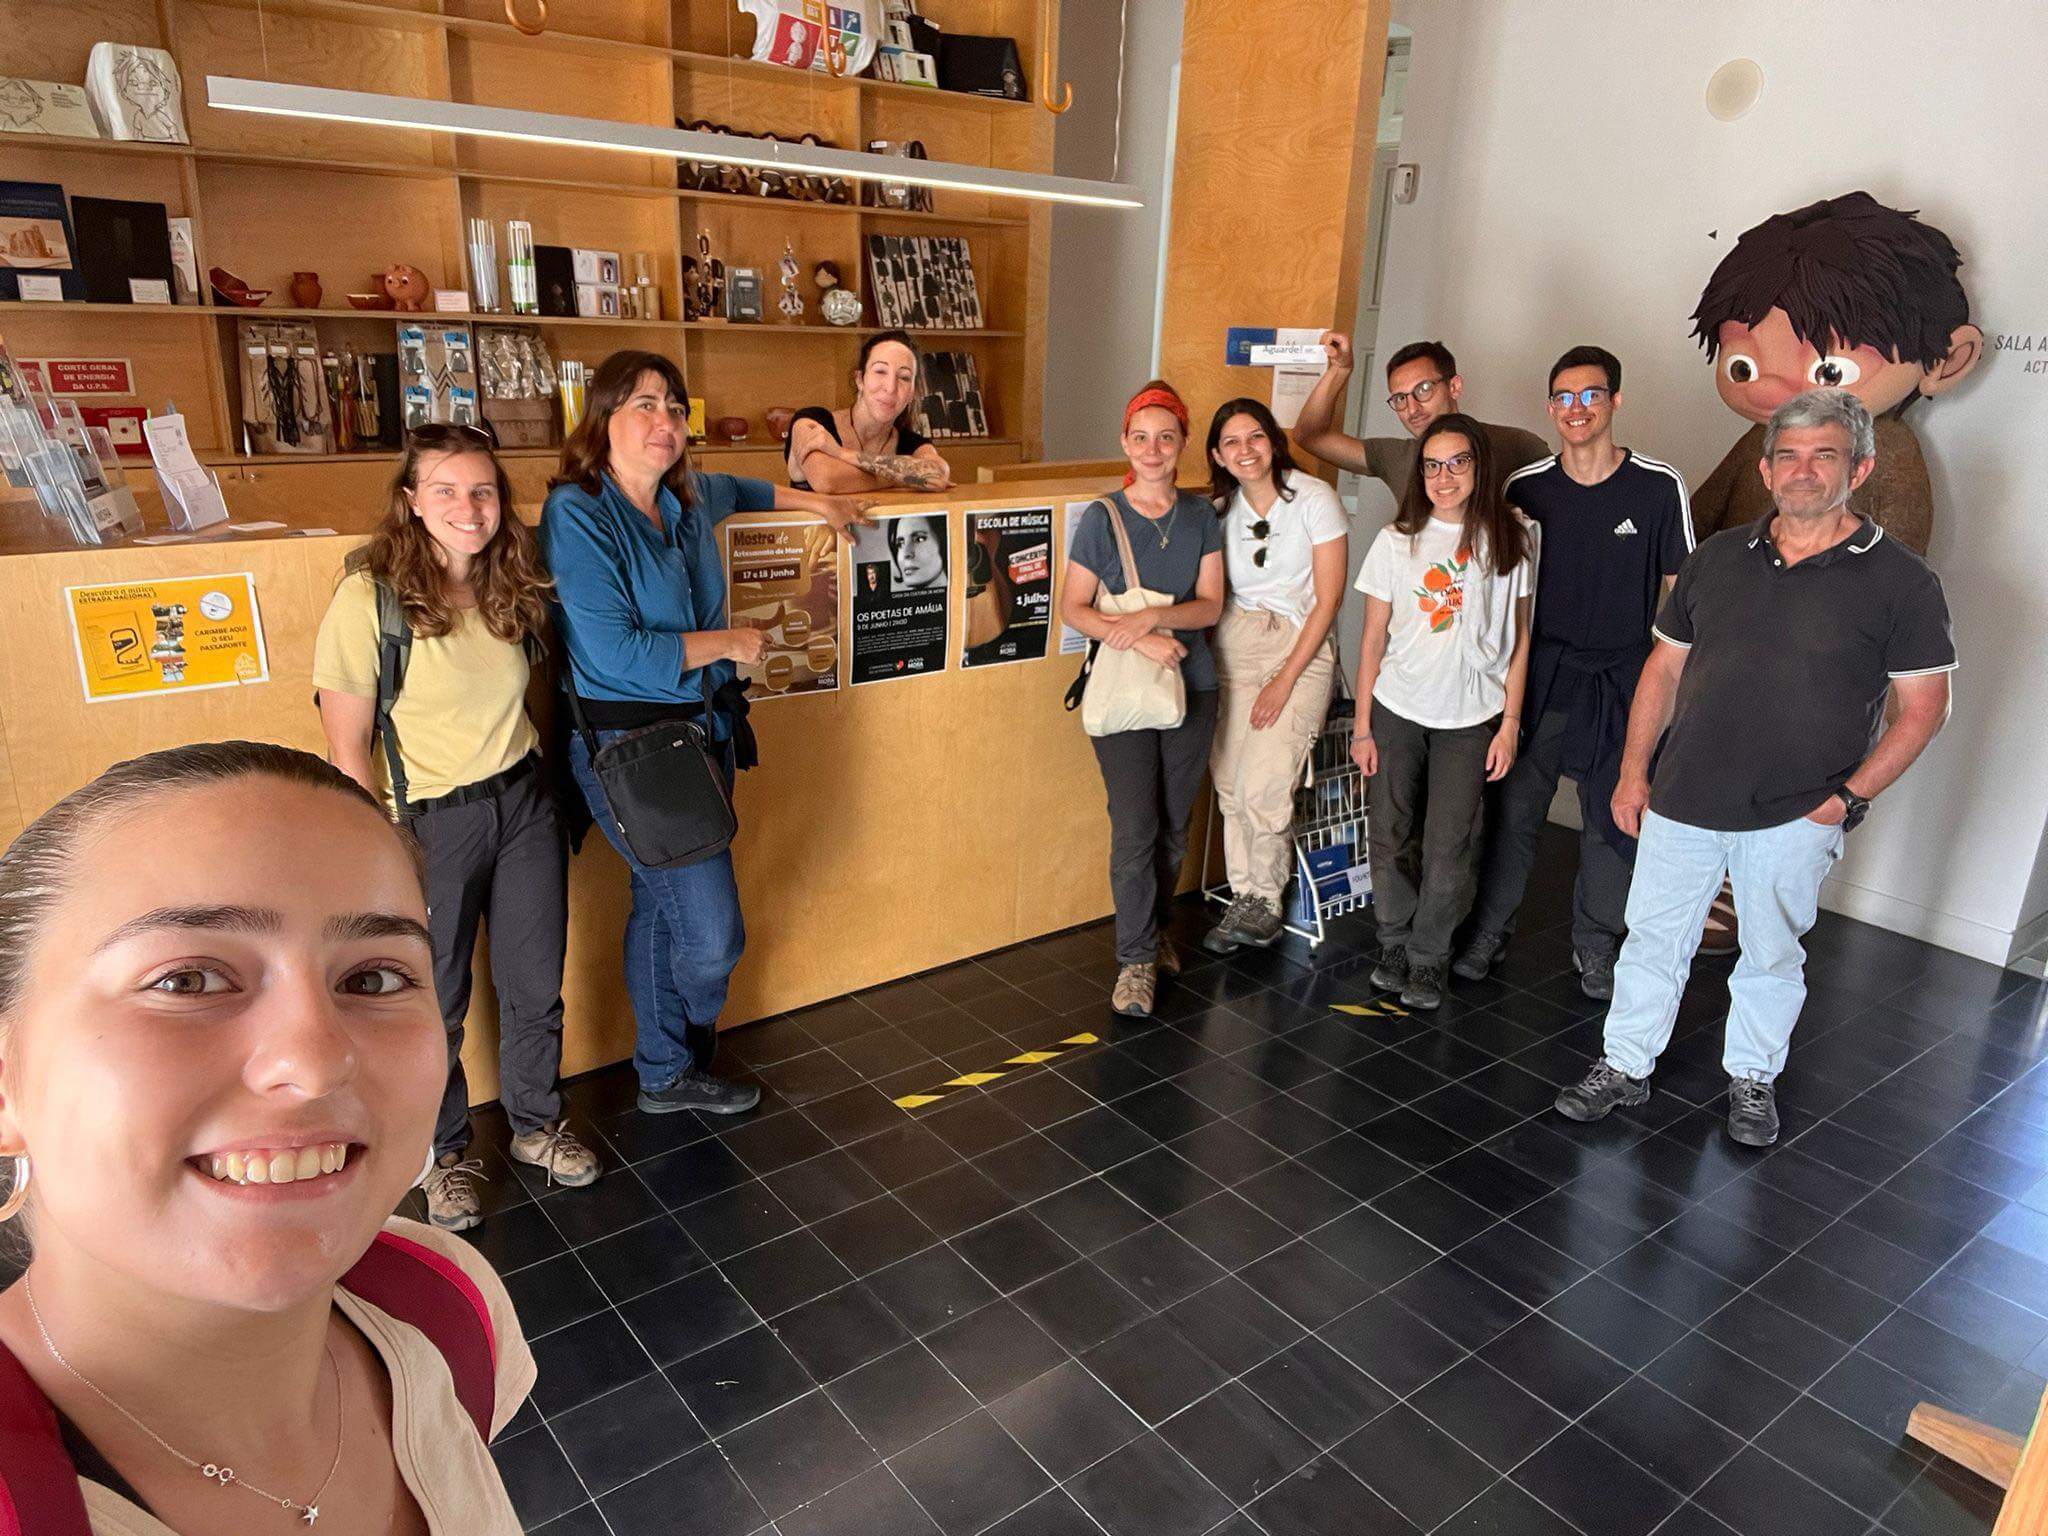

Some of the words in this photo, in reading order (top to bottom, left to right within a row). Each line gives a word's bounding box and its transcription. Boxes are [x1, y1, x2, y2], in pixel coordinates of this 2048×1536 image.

[1994, 334, 2032, 351] SALA
[57, 364, 88, 372] CORTE
[90, 364, 119, 372] GERAL
[63, 373, 76, 381] DE
[77, 373, 116, 381] ENERGIA
[977, 516, 1008, 529] ESCOLA
[1009, 516, 1020, 527] DE
[1021, 512, 1049, 526] MÚSICA
[733, 529, 775, 546] Mostra
[777, 531, 789, 545] de
[733, 548, 774, 558] Artesanato
[785, 546, 804, 555] Mora
[1009, 549, 1047, 565] CONCERTO
[742, 571, 751, 579] 17
[759, 570, 768, 578] 18
[770, 568, 795, 580] junho
[1016, 595, 1023, 605] 1
[1023, 592, 1049, 607] julho
[856, 612, 870, 622] OS
[870, 607, 902, 620] POETAS
[903, 606, 913, 616] DE
[914, 602, 943, 615] AMÁLIA
[194, 627, 228, 636] CARIMBE
[229, 625, 248, 633] AQUI
[870, 621, 888, 629] JUNHO
[200, 641, 248, 651] PASSAPORTE
